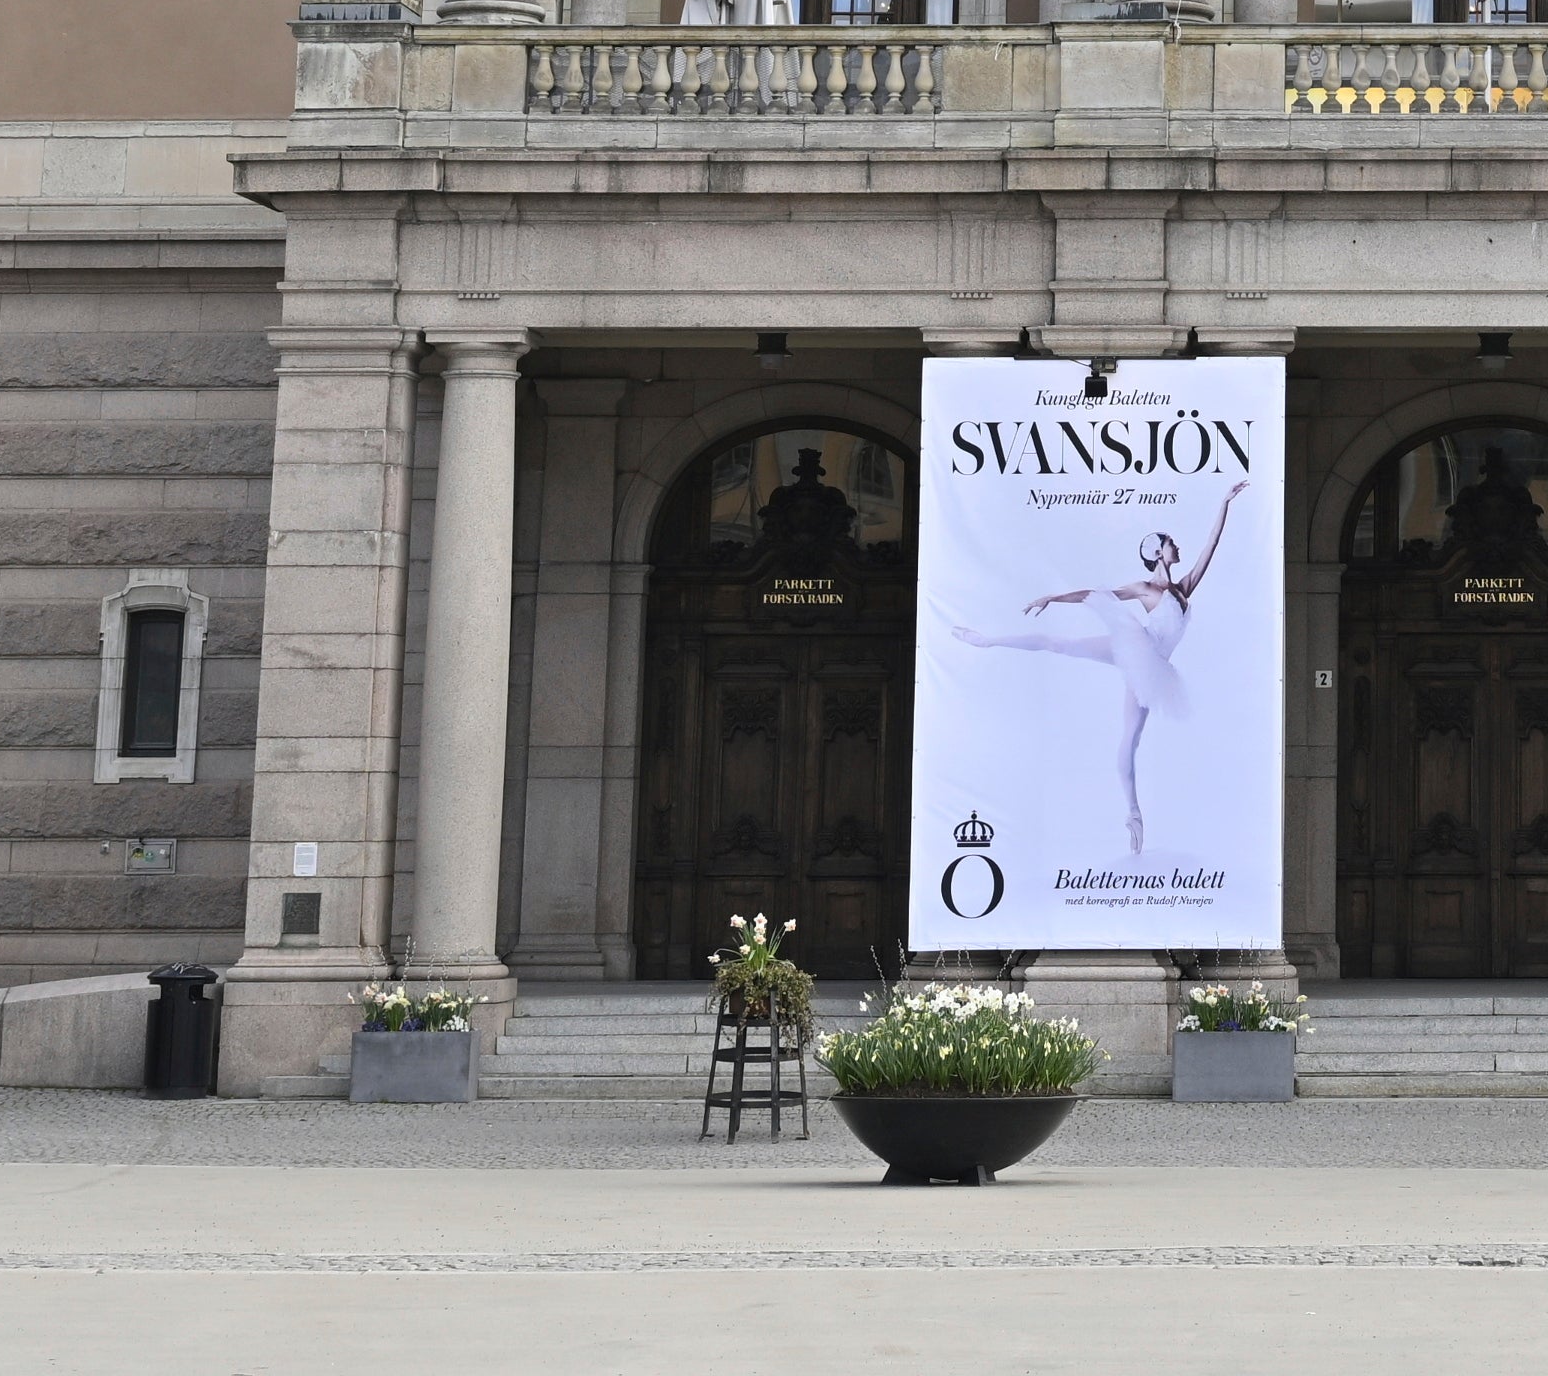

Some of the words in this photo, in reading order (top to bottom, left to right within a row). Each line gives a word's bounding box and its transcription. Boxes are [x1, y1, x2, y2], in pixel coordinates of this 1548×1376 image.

[1034, 389, 1104, 410] Kungliga
[1109, 389, 1171, 406] Baletten
[952, 409, 1255, 475] SVANSJÖN
[1027, 489, 1110, 509] Nypremiär
[1112, 489, 1136, 505] 27
[1138, 493, 1177, 505] mars
[774, 579, 835, 590] PARKETT
[1464, 578, 1525, 588] PARKETT
[808, 594, 844, 604] RADEN
[1498, 592, 1535, 603] RADEN
[1320, 672, 1328, 686] 2
[1054, 868, 1166, 890] Baletternas
[1171, 868, 1226, 890] balett
[1065, 896, 1084, 905] med
[1086, 895, 1130, 908] koreografi
[1146, 895, 1178, 908] Rudolf
